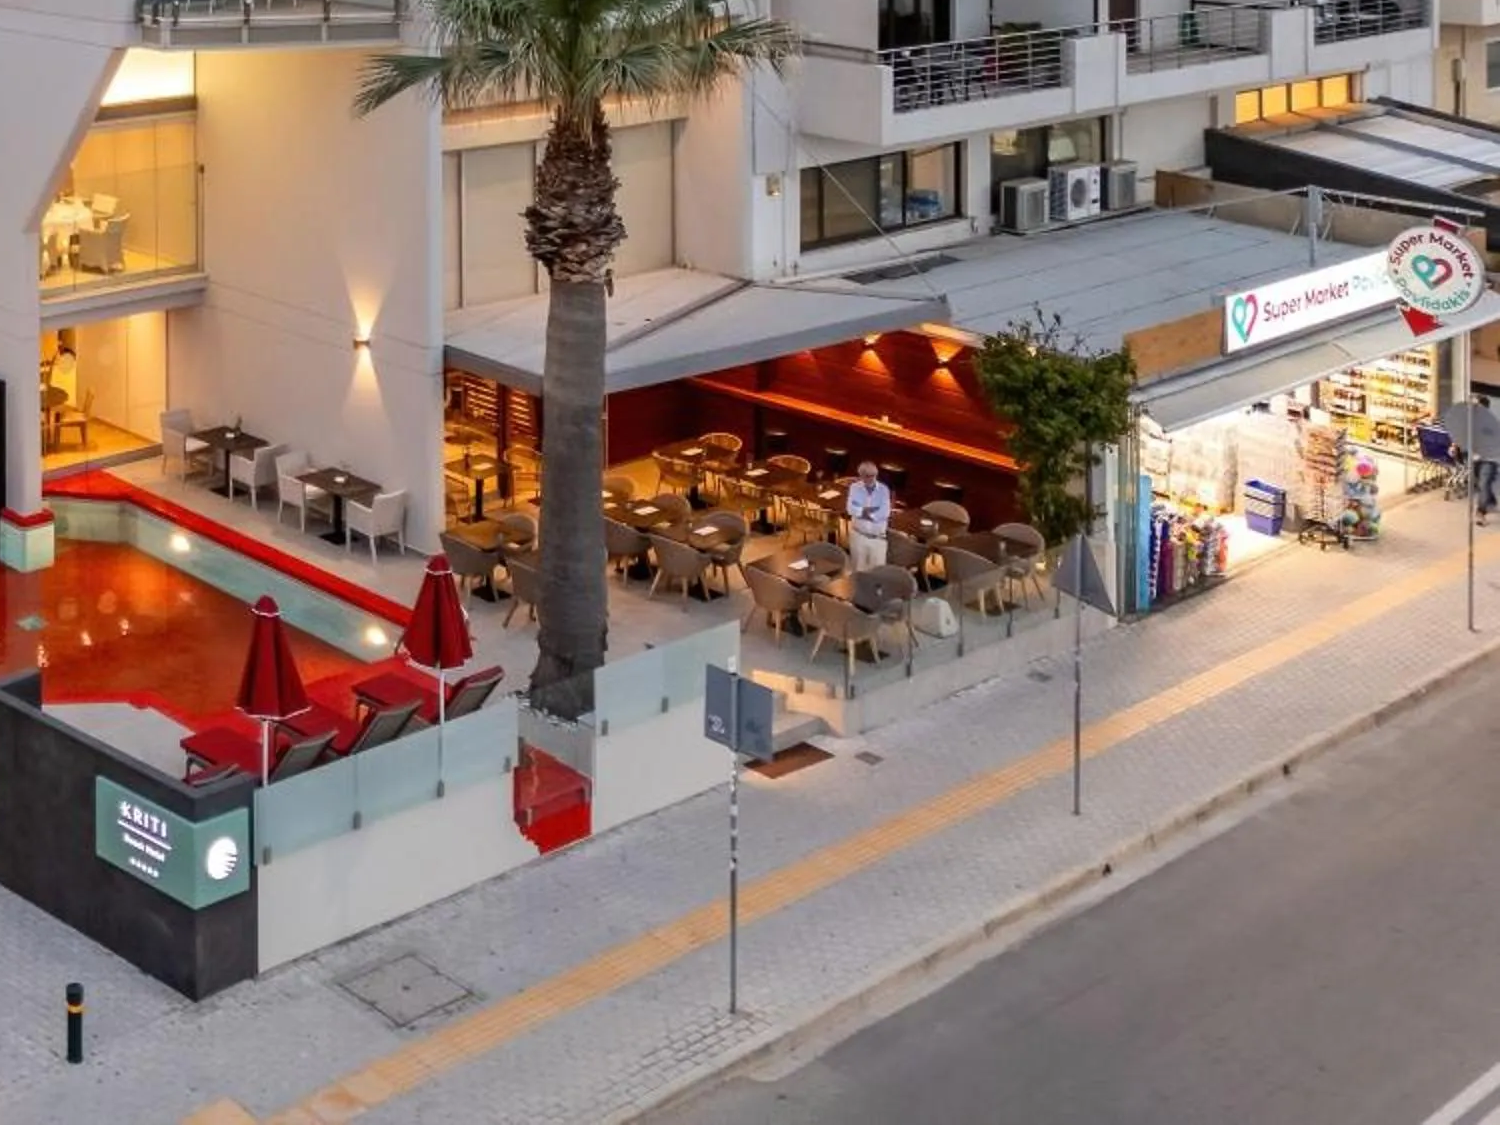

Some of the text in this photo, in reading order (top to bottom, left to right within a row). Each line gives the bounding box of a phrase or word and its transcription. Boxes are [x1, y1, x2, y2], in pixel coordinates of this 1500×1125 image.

[1389, 232, 1475, 280] Super Market
[1263, 297, 1302, 322] Super
[1305, 282, 1348, 307] Market
[120, 801, 167, 837] KRITI
